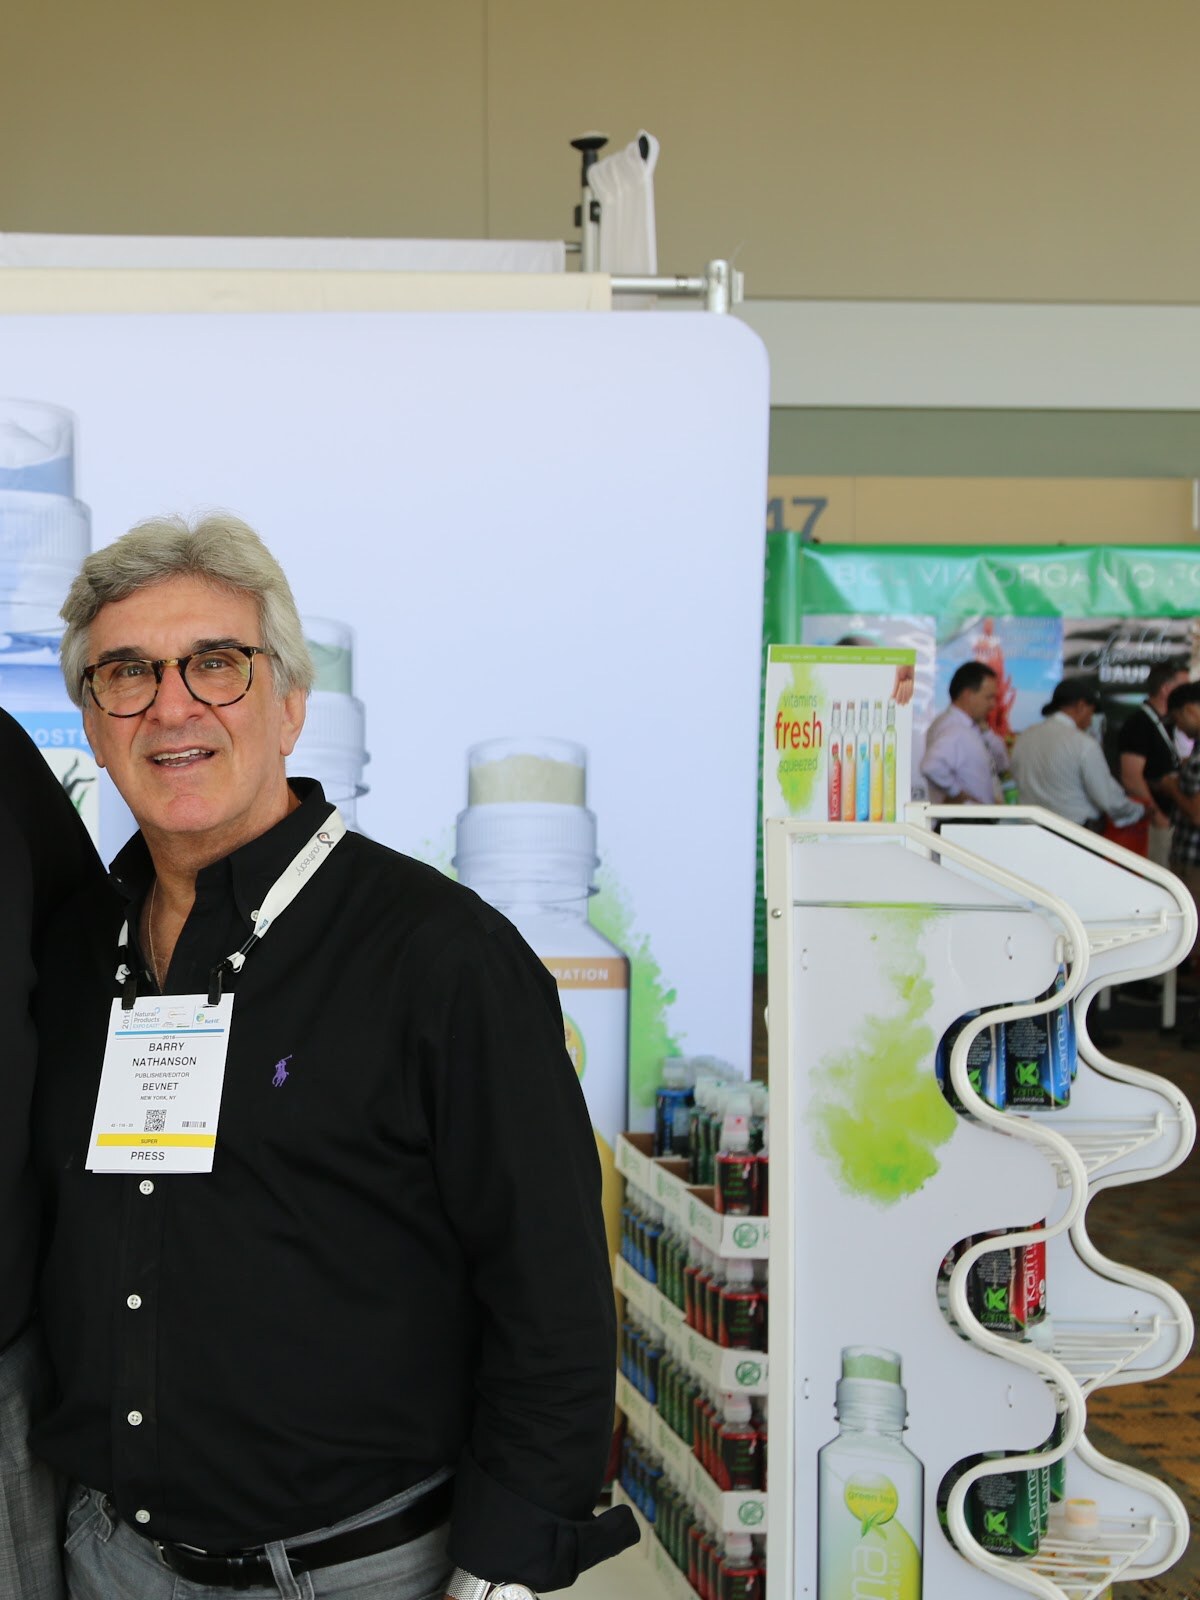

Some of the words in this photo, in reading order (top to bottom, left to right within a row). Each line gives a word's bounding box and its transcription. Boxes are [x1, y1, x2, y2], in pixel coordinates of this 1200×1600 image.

[991, 562, 1156, 588] ORGANIC
[783, 693, 818, 708] vitamins
[775, 712, 823, 750] fresh
[778, 757, 819, 774] squeezed
[553, 968, 609, 981] RATION
[149, 1042, 184, 1052] BARRY
[1057, 1014, 1069, 1088] karma
[132, 1057, 197, 1067] NATHANSON
[142, 1082, 179, 1091] BEVNET
[130, 1151, 165, 1161] PRESS
[847, 1491, 878, 1502] green
